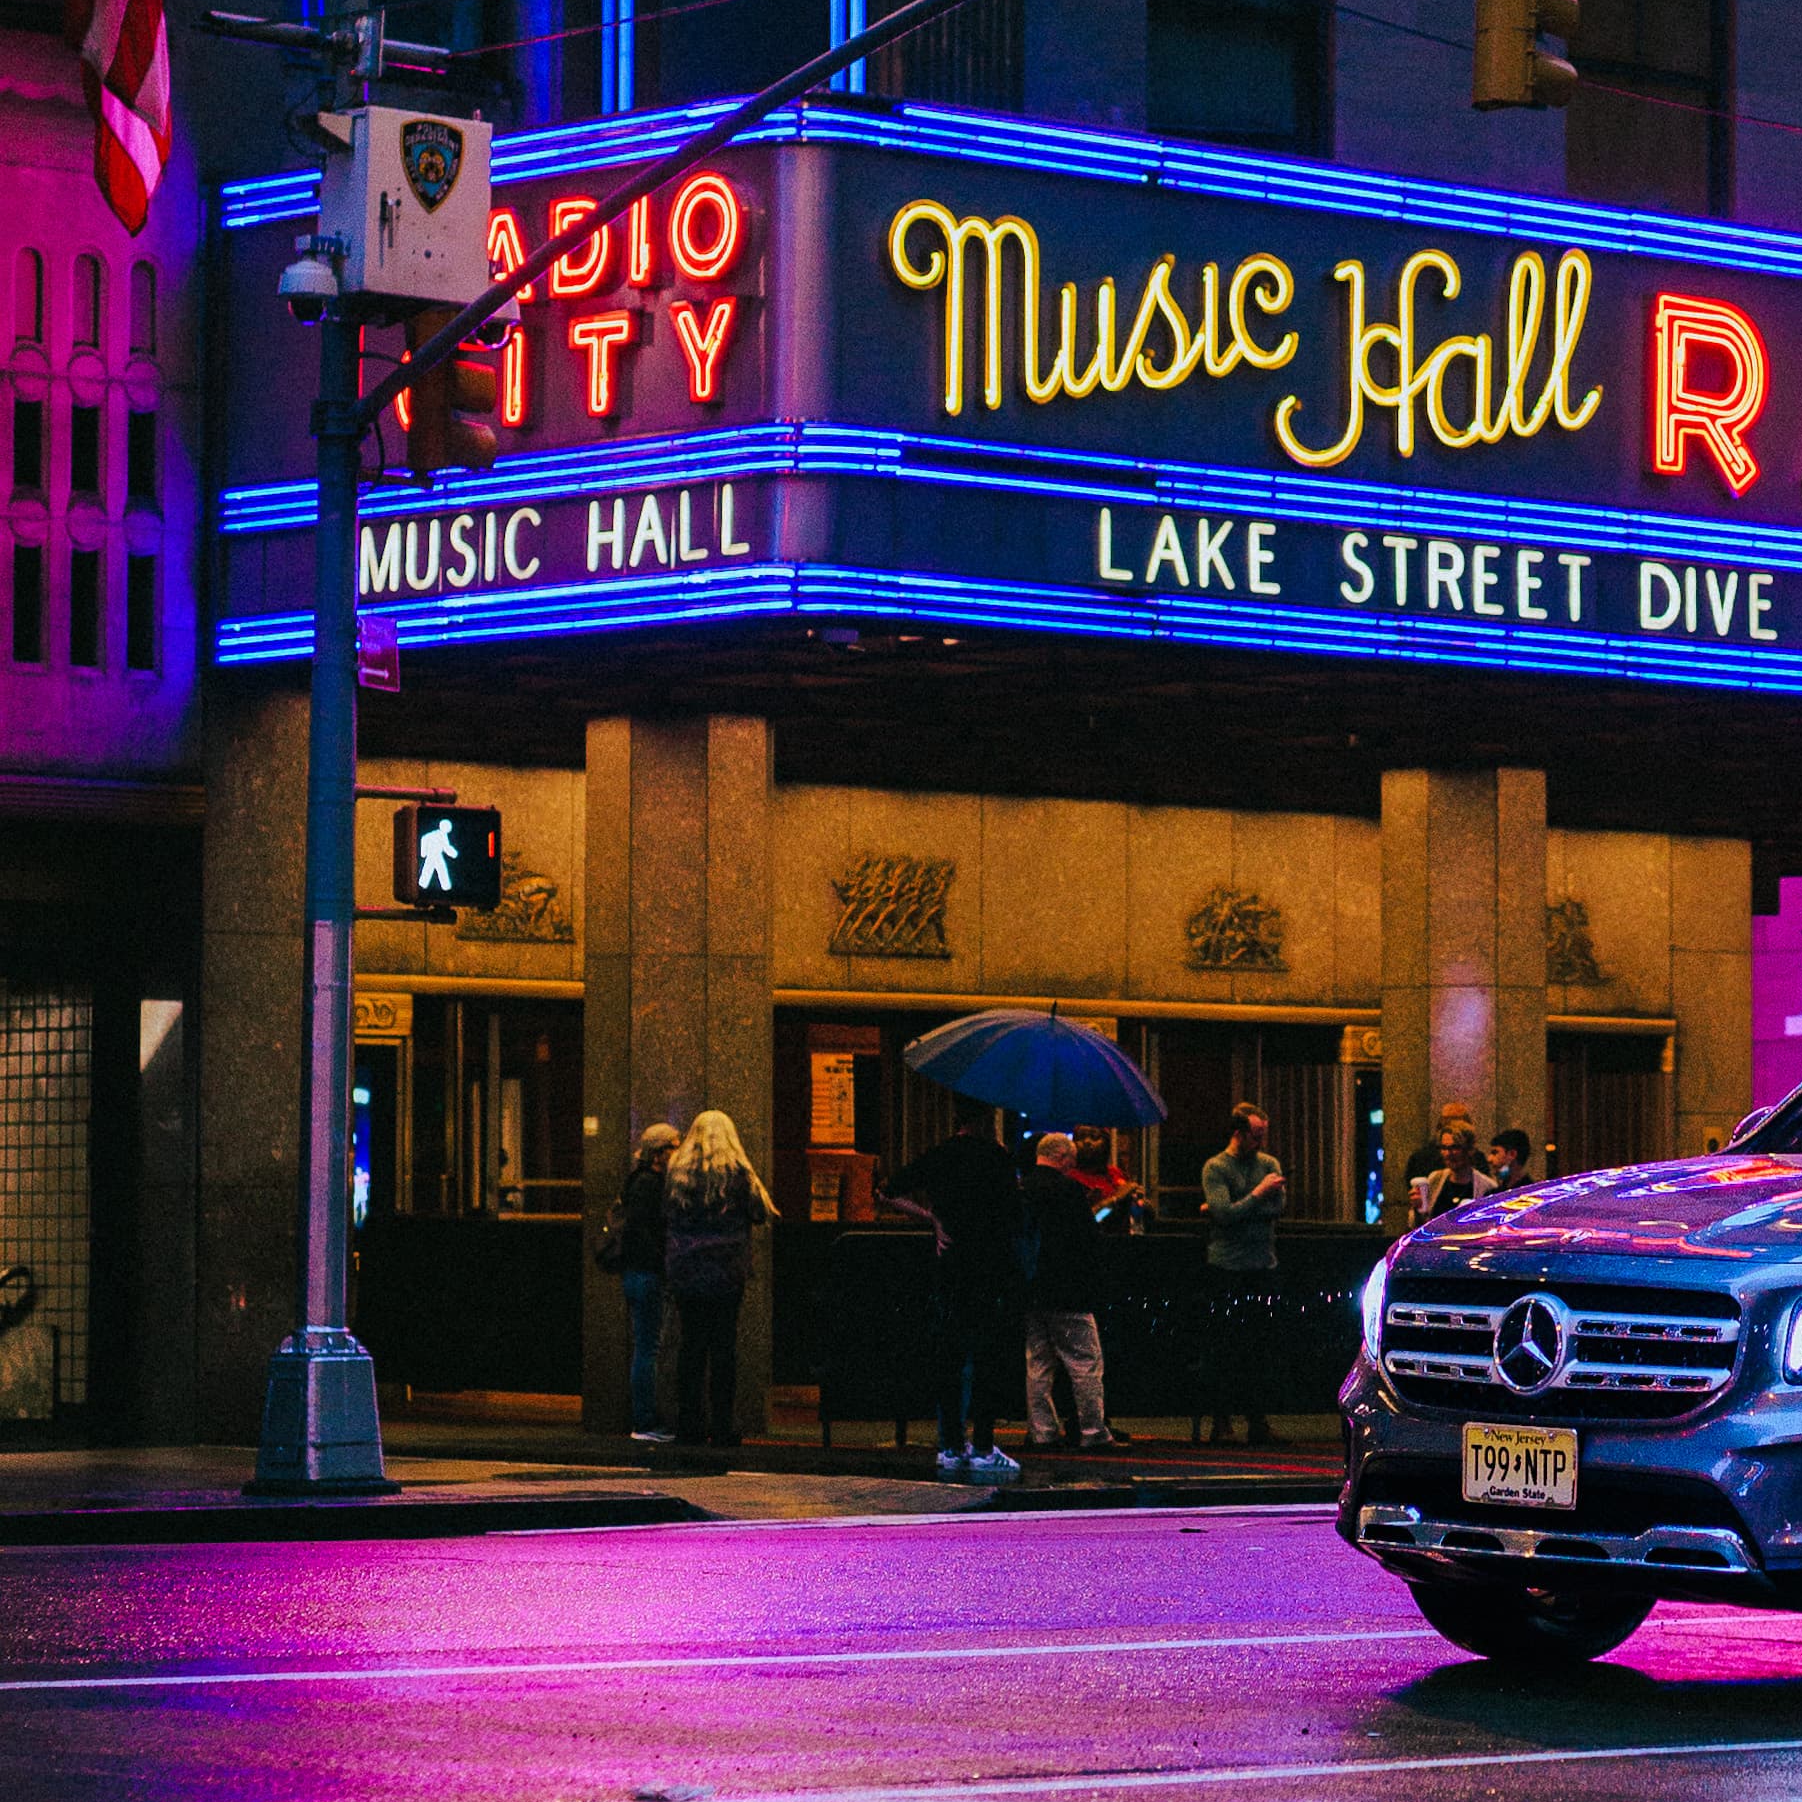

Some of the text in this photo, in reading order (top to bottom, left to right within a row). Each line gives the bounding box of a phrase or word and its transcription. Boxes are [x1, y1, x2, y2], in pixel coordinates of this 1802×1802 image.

[487, 171, 739, 303] ADIO
[396, 296, 738, 432] ITY
[888, 199, 1299, 416] Music
[1276, 249, 1602, 467] Hall
[358, 483, 750, 596] MUSIC HALL
[1099, 506, 1282, 595] LAKE
[1341, 531, 1592, 622] STREET
[1639, 562, 1778, 641] DIVE
[1489, 1485, 1546, 1500] Garden State
[1490, 1429, 1546, 1447] New Jersey
